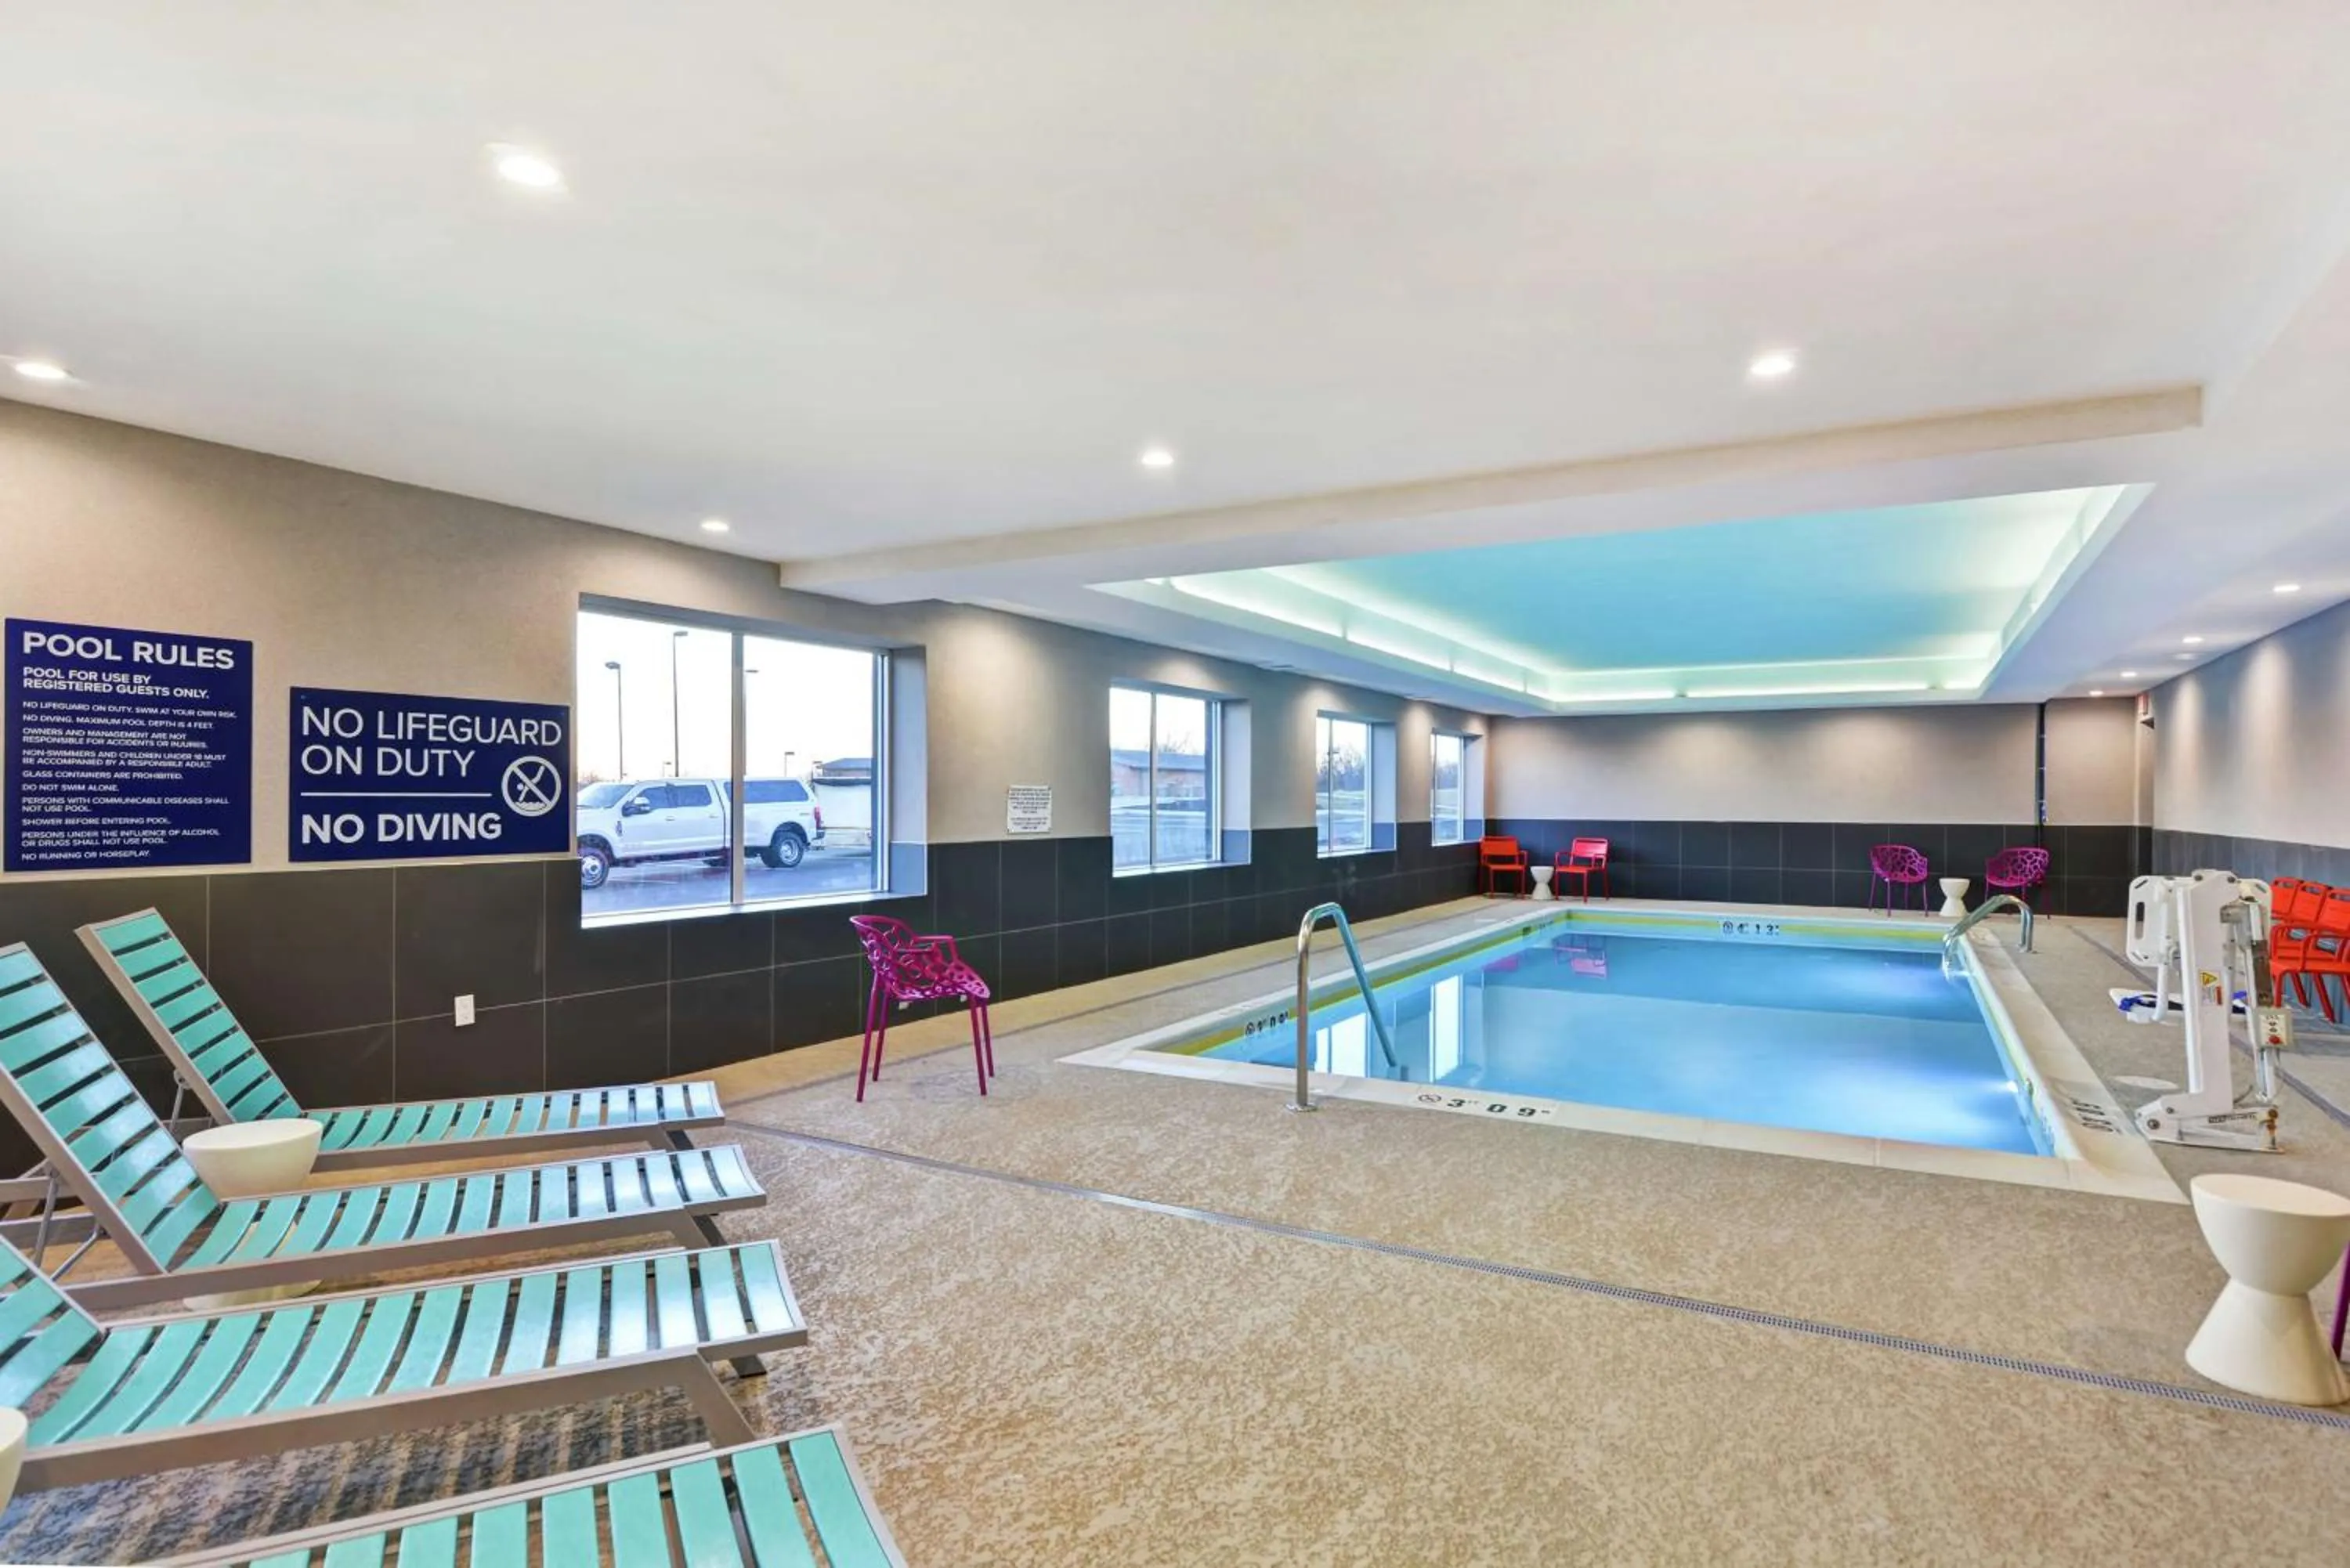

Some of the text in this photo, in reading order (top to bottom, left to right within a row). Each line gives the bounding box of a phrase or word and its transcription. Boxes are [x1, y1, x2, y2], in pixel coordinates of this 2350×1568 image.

[23, 631, 235, 670] POOL RULES
[23, 667, 151, 685] POOL FOR USE BY
[23, 677, 210, 699] REGISTERED GUESTS ONLY.
[40, 702, 90, 712] LIFEGUARD
[107, 705, 133, 714] DUTY.
[40, 714, 74, 723] DIVING.
[76, 716, 121, 724] MAXIMUM
[122, 718, 146, 727] POOL
[302, 706, 562, 746] NO LIFEGUARD
[22, 727, 63, 736] OWNERS
[87, 730, 150, 739] MANAGEMENT
[22, 735, 85, 745] RESPONSIBLE
[107, 739, 155, 747] ACCIDENTS
[22, 749, 96, 758] NON-SWIMMERS
[118, 751, 162, 760] CHILDREN
[301, 744, 476, 777] ON DUTY
[37, 757, 103, 766] ACCOMPANIED
[127, 759, 184, 768] RESPONSIBLE
[54, 771, 112, 779] CONTAINERS
[302, 811, 503, 844] NO DIVING
[22, 830, 65, 839] PERSONS
[22, 852, 38, 861] NO
[38, 851, 82, 860] RUNNING
